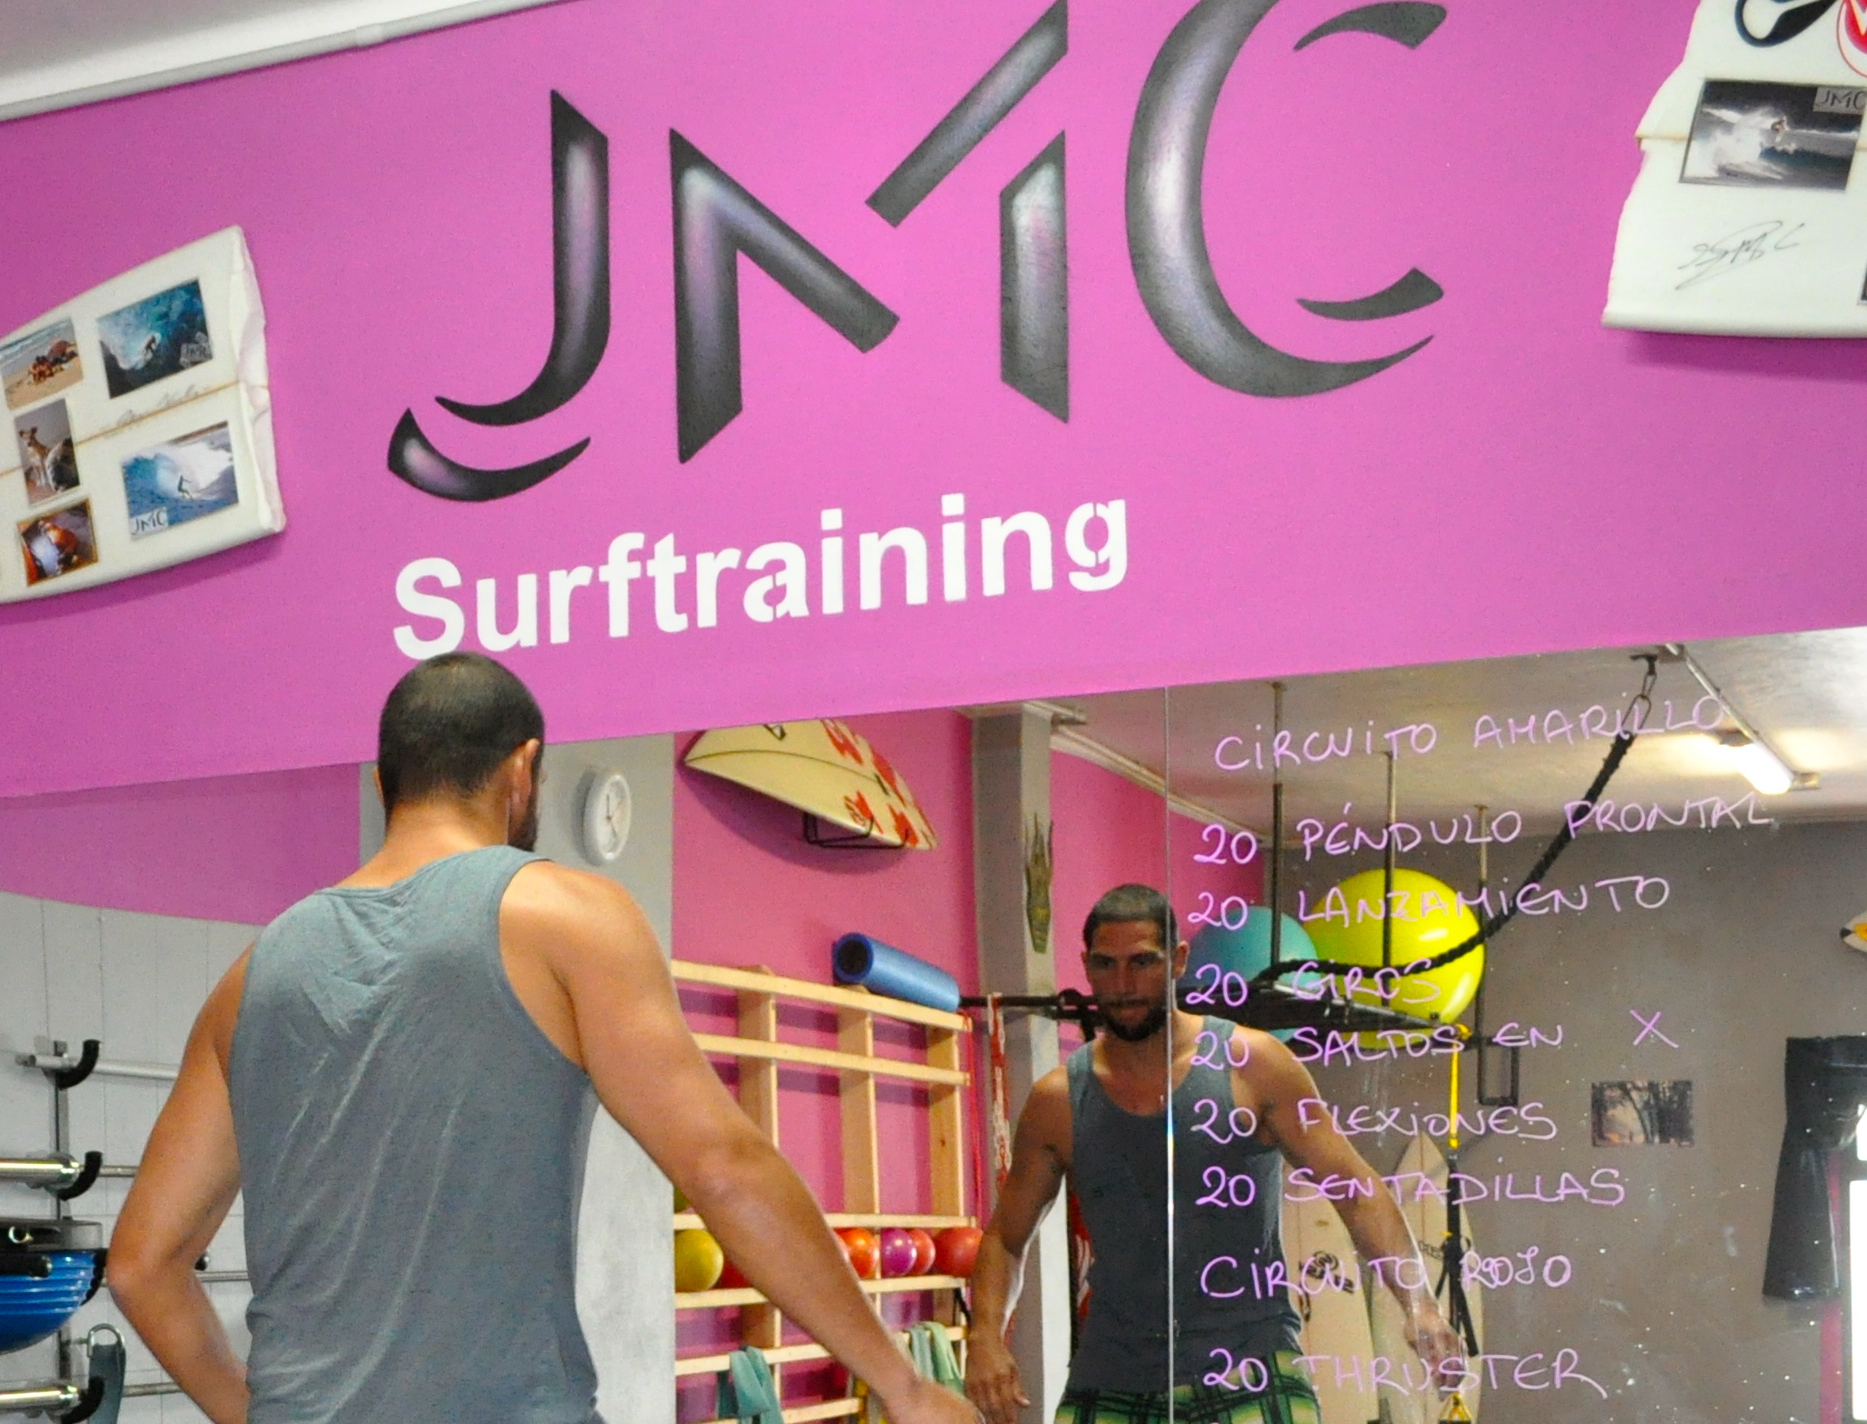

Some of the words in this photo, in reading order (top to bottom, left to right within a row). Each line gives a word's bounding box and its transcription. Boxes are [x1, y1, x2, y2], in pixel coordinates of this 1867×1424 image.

[386, 0, 1447, 503] JMC
[133, 507, 167, 534] JMC
[392, 492, 1130, 661] Surftraining
[1193, 823, 1258, 865] 20
[1187, 892, 1250, 931] 20
[1185, 963, 1248, 1007] 20
[1190, 1031, 1250, 1070] 20
[1292, 1025, 1465, 1067] SALTOS
[1495, 1022, 1563, 1049] EN
[1190, 1098, 1257, 1144] 20
[1194, 1164, 1258, 1208] 20
[1201, 1349, 1269, 1393] 20
[1292, 1348, 1608, 1399] THRUSTER
